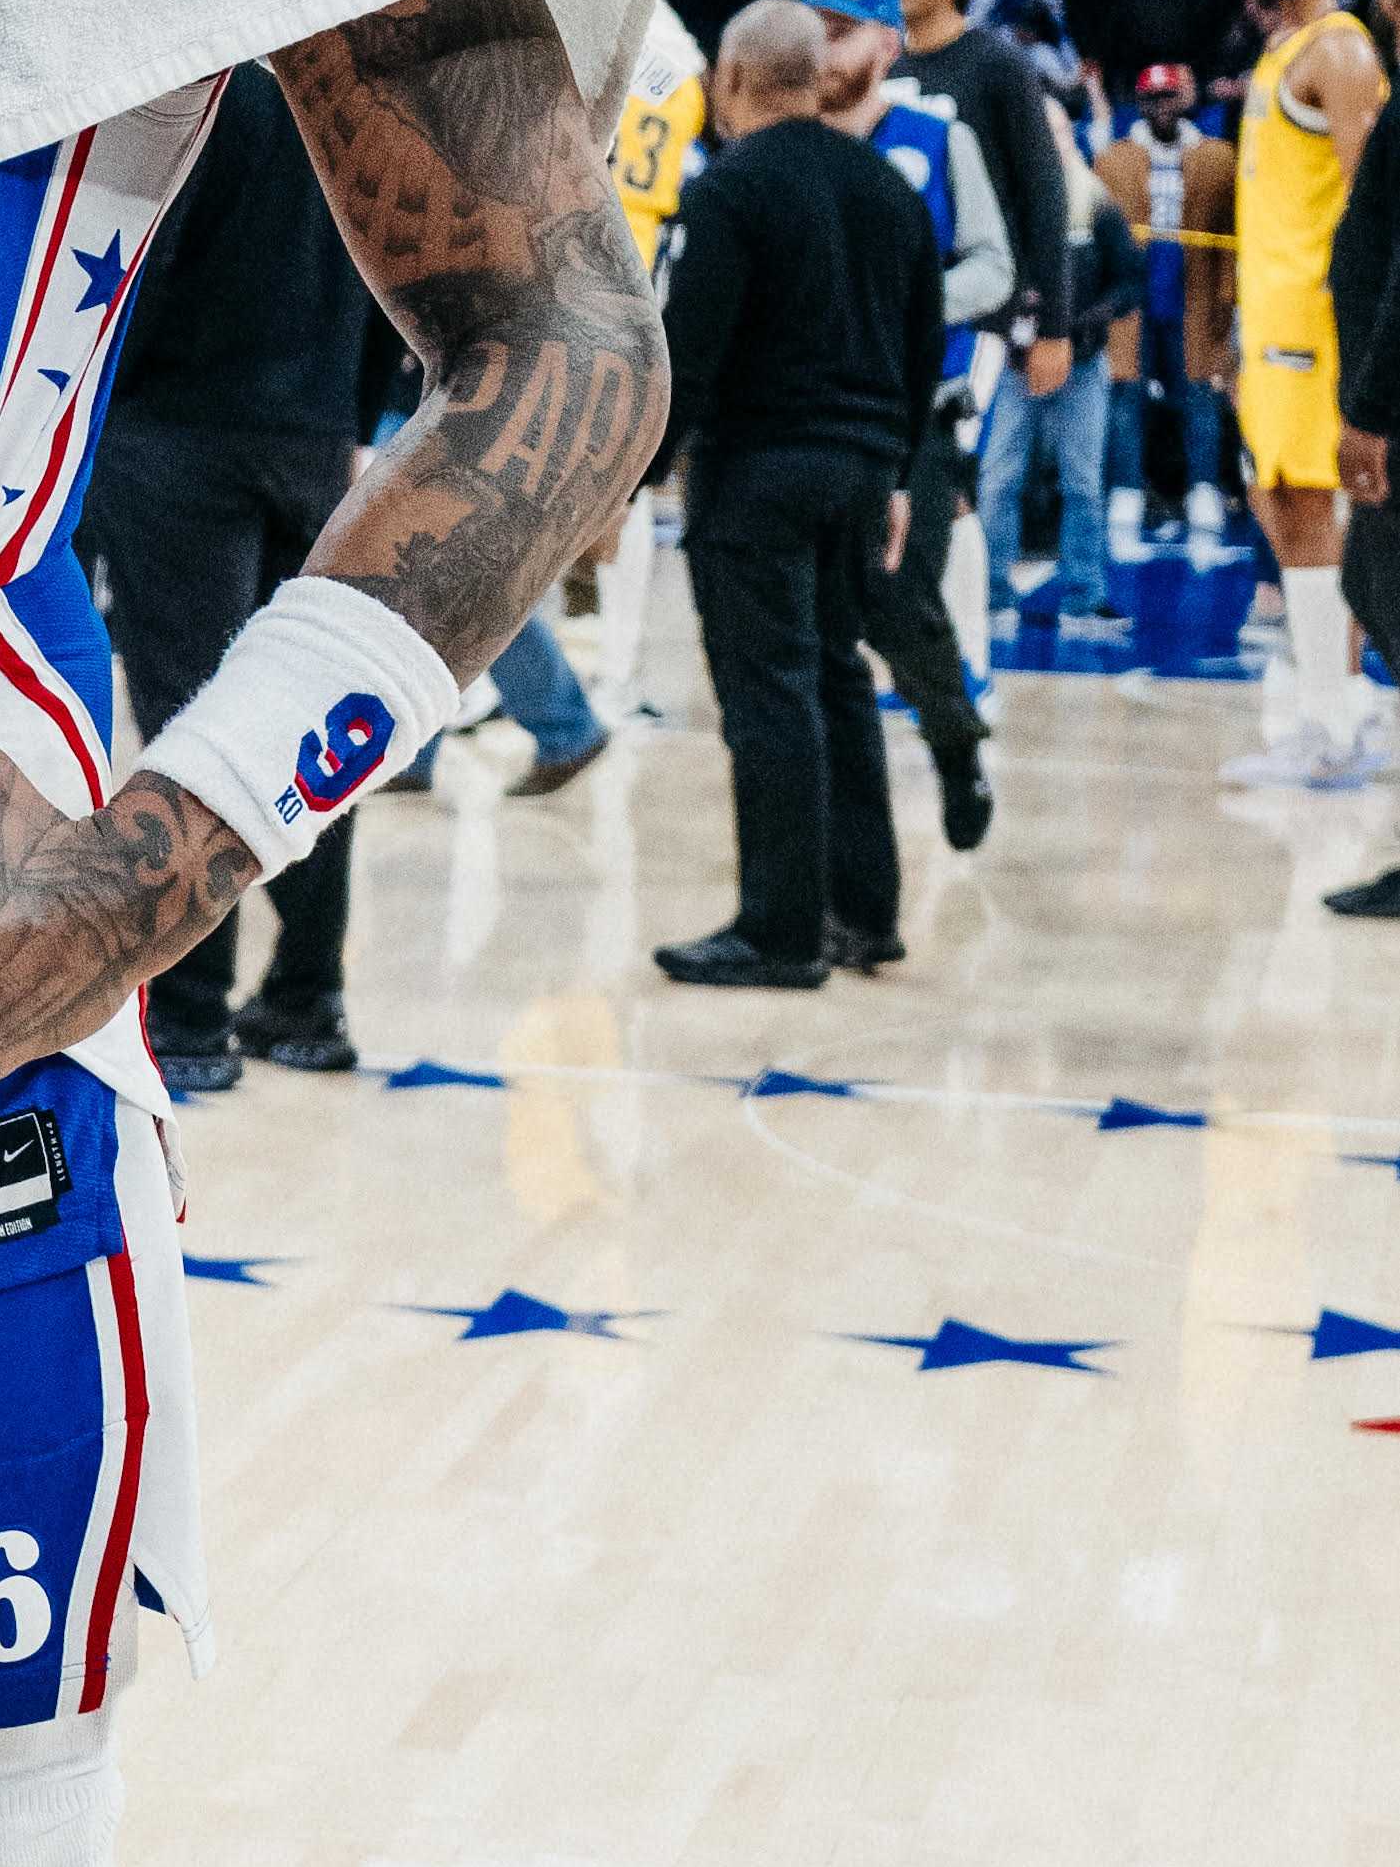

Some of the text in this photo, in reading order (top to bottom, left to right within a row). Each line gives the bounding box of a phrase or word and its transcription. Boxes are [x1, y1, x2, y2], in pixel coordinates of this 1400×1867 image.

[607, 114, 671, 193] 3
[294, 693, 396, 813] 9
[5, 1217, 33, 1237] EDITION
